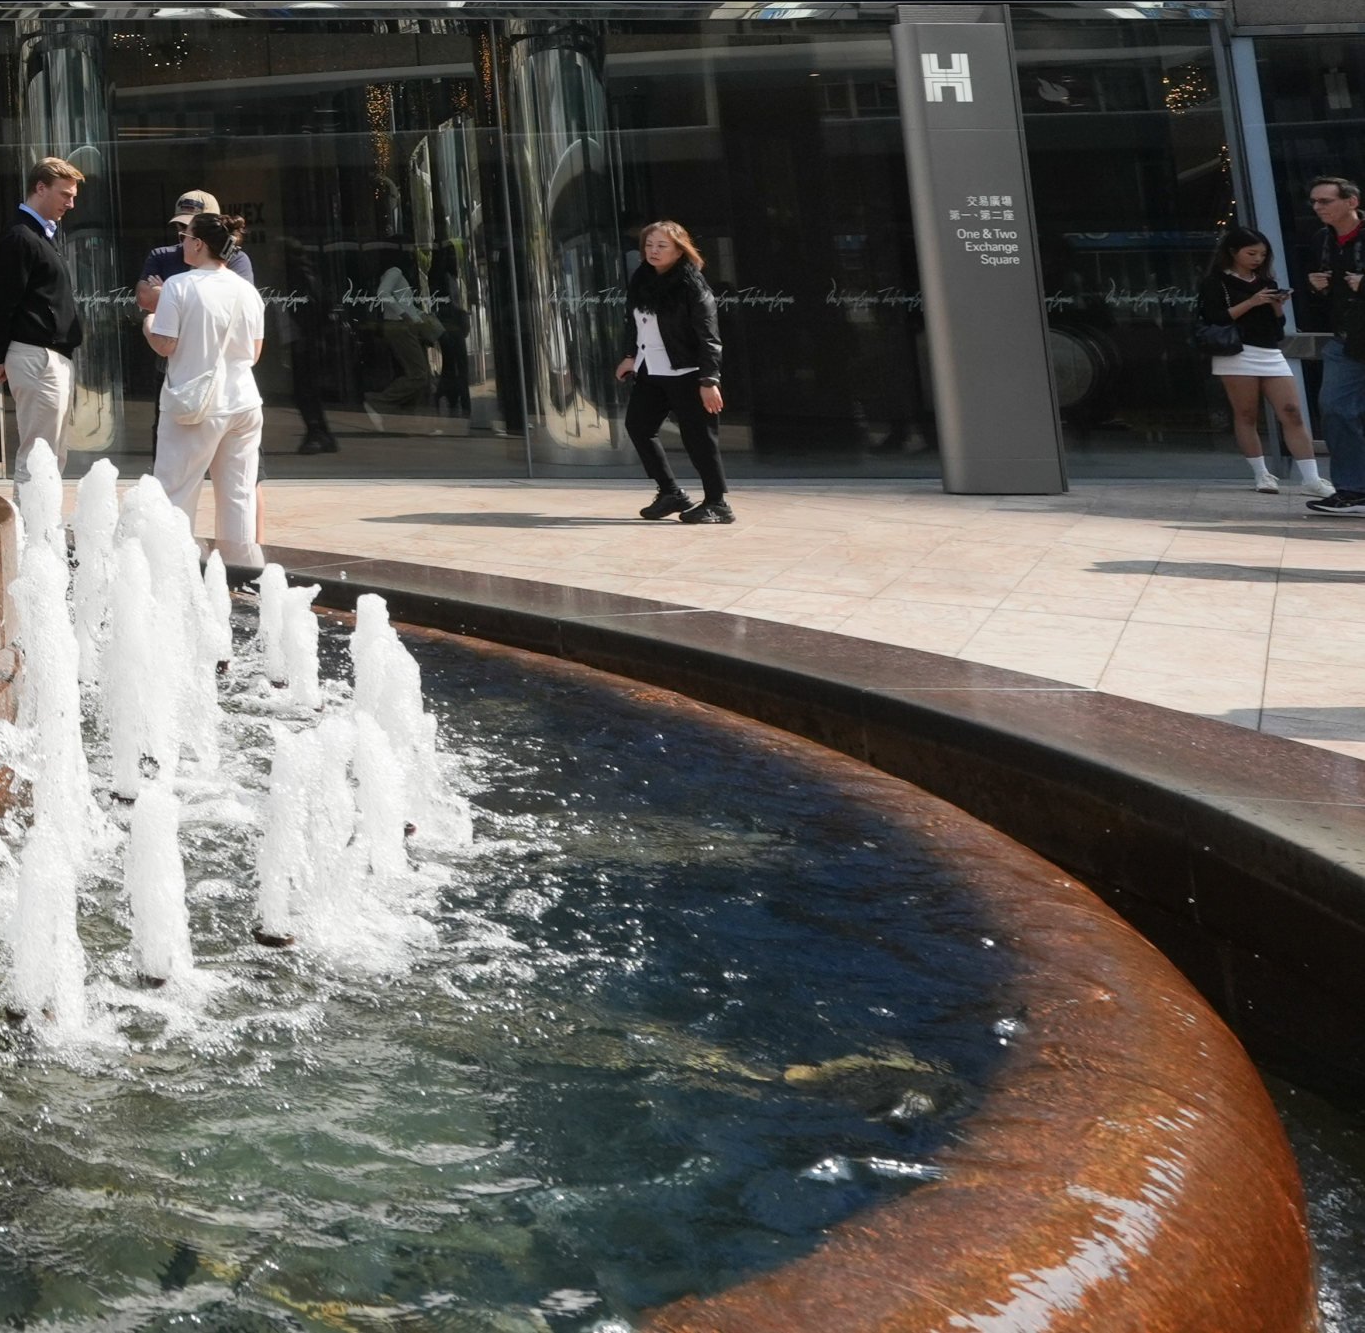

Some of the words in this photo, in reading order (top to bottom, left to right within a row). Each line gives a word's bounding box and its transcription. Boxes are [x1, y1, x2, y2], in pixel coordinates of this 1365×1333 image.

[966, 196, 1013, 207] 交易廣場
[957, 229, 979, 238] One
[983, 229, 992, 238] &
[993, 229, 1017, 238] Two
[965, 242, 1018, 253] Exchange
[981, 254, 1019, 266] Square
